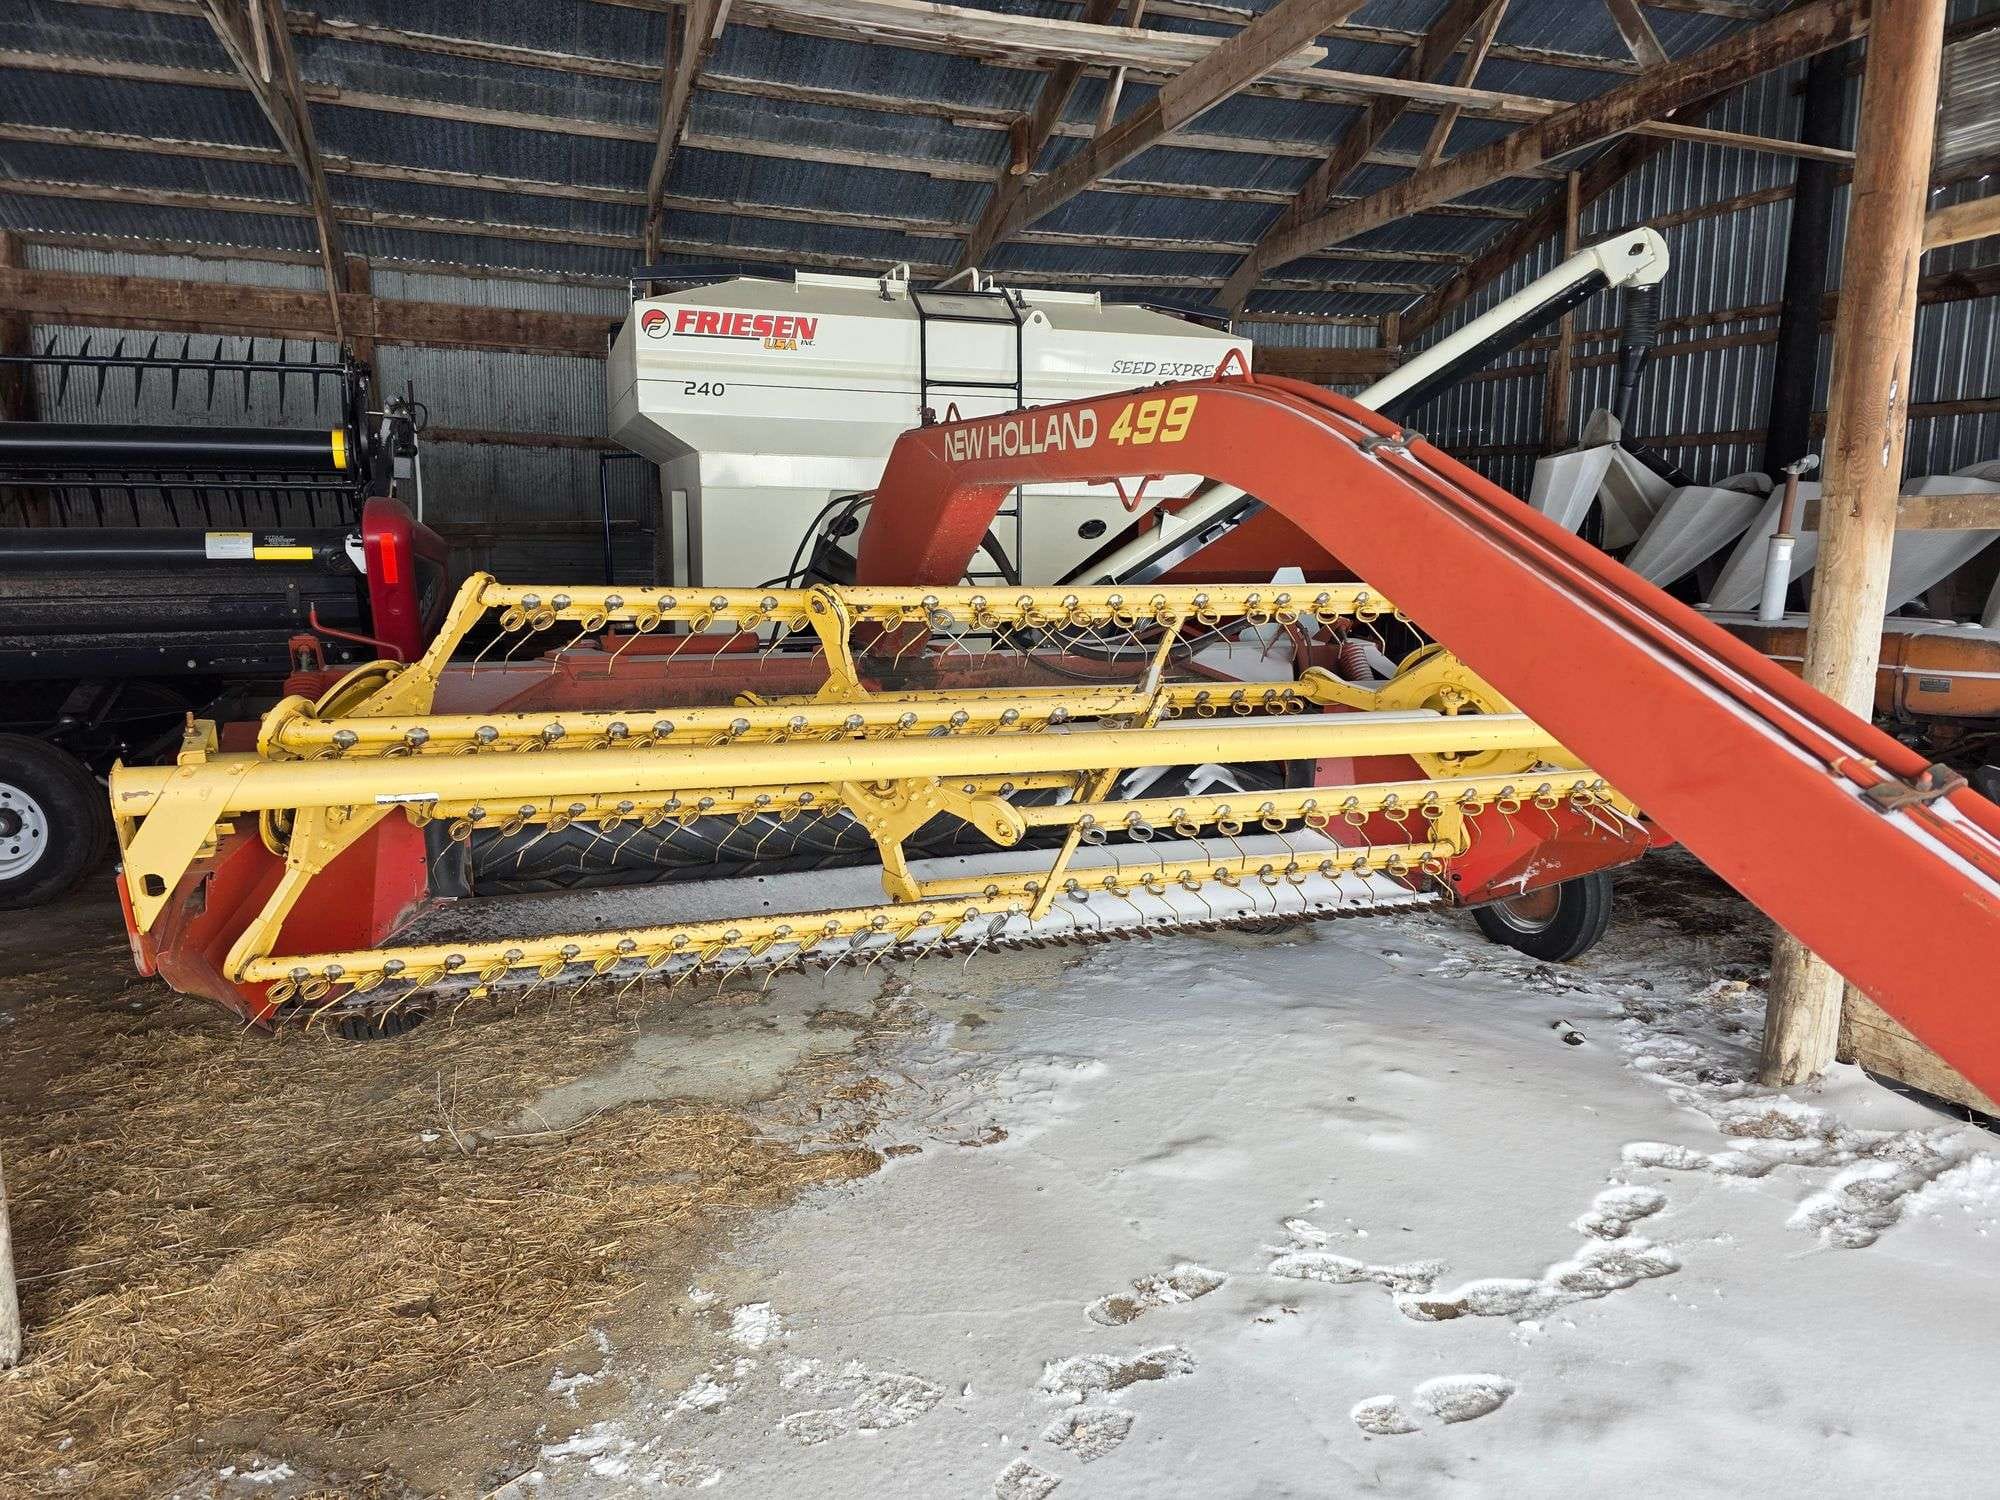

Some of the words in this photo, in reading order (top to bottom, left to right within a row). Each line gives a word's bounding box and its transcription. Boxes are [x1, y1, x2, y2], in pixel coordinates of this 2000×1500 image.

[674, 309, 819, 340] FRIESEN
[763, 338, 798, 351] USA
[800, 339, 816, 347] INC.
[1111, 360, 1157, 375] SEED
[1158, 362, 1234, 377] EXPRES
[684, 381, 725, 397] 240
[944, 426, 984, 463] NEW
[988, 408, 1098, 458] HOLLAND
[1108, 395, 1199, 446] 499
